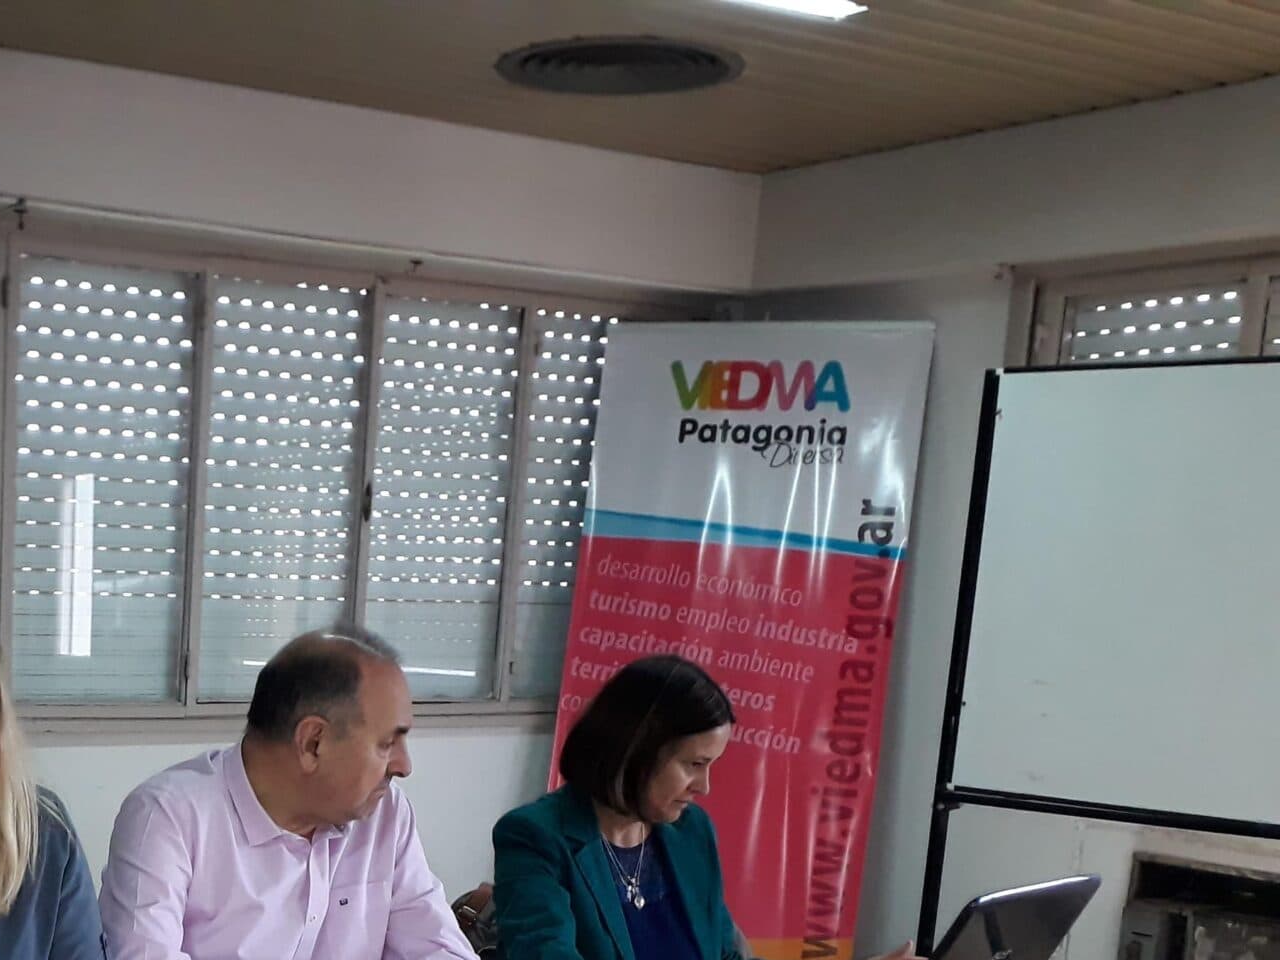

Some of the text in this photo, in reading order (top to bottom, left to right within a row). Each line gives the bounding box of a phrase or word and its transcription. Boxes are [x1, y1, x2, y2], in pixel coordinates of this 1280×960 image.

[678, 417, 848, 451] Patagonia
[597, 552, 803, 607] desarrollo económico
[588, 588, 860, 655] turismo empleo industria
[571, 655, 626, 681] terri
[579, 626, 815, 684] capacitación ambiente
[802, 497, 897, 960] www.viedma.gov.ar
